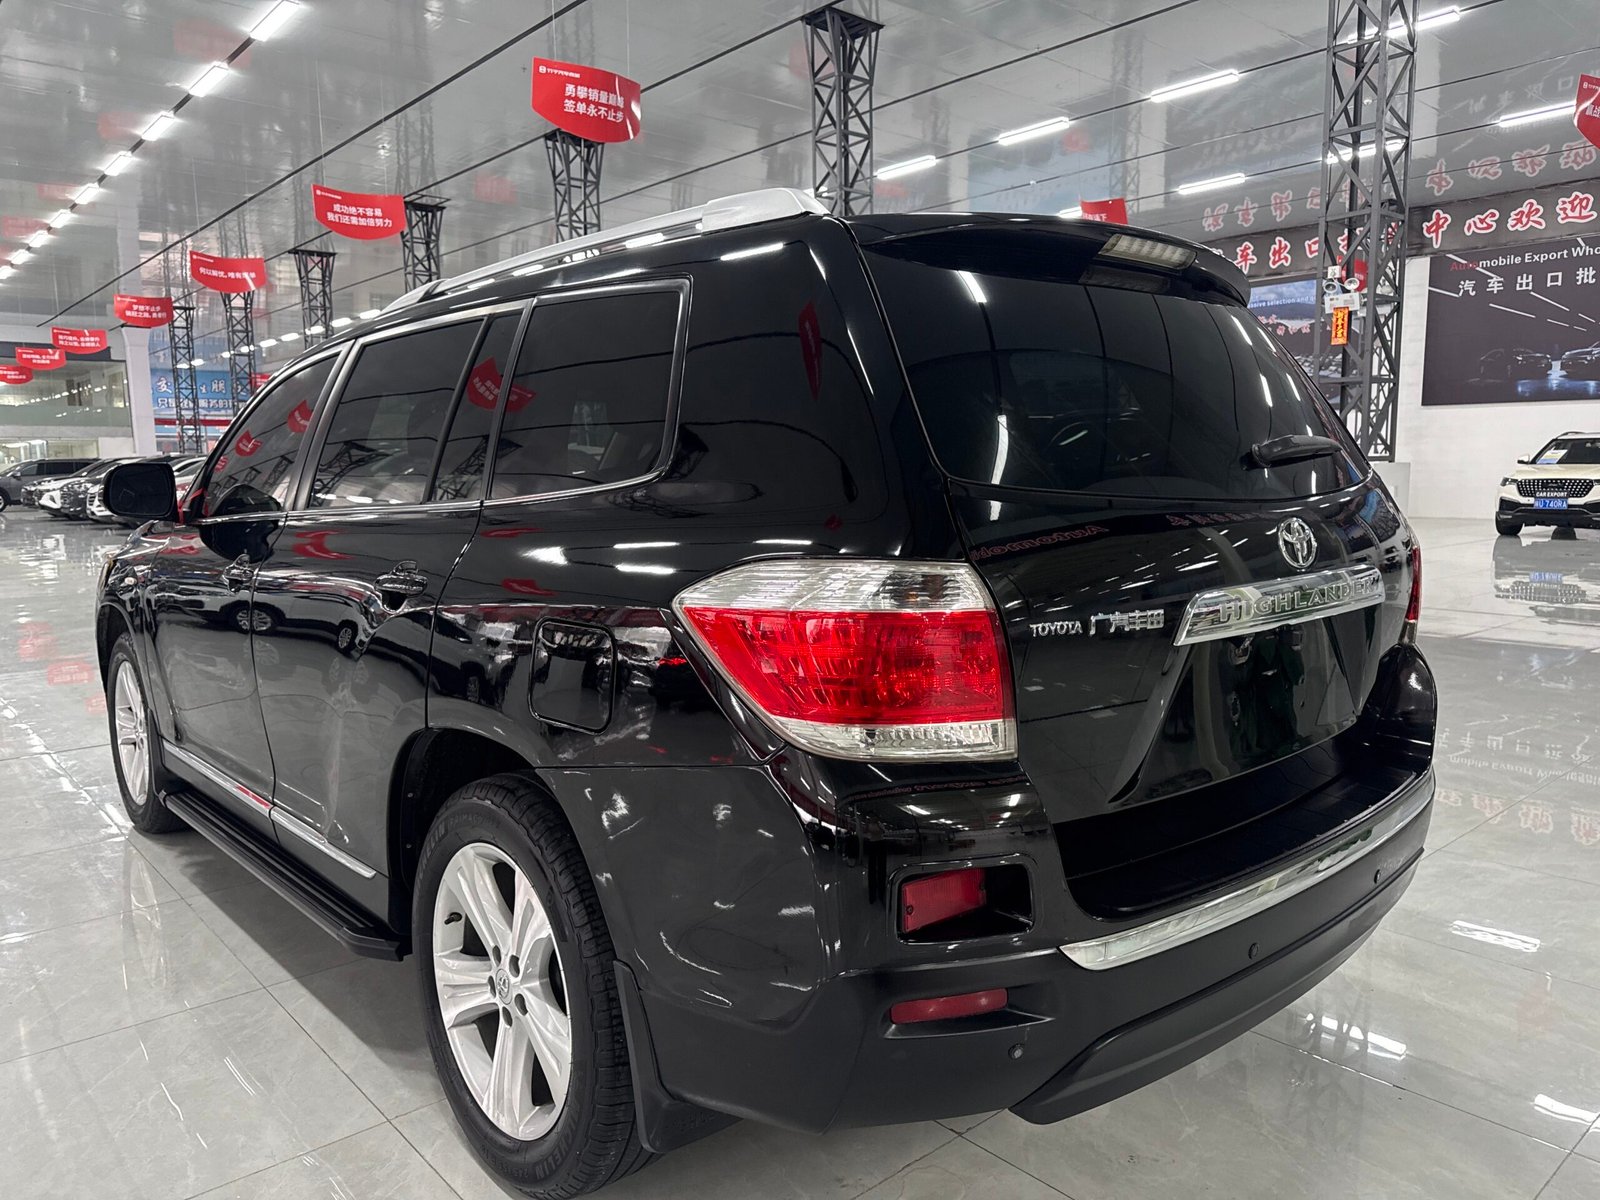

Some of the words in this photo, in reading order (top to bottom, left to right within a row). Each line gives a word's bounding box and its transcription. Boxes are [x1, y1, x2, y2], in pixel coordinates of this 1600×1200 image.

[563, 99, 624, 123] 签单永不止步
[326, 211, 393, 228] 我们还需加倍努力
[333, 203, 383, 217] 成功绝不容易
[1524, 249, 1569, 264] Export
[1458, 266, 1597, 297] 汽车出口批
[1267, 298, 1295, 306] selection
[1219, 577, 1375, 621] HIGHLANDER
[1029, 621, 1083, 638] TOYOTA
[1089, 609, 1164, 637] 广汽丰田
